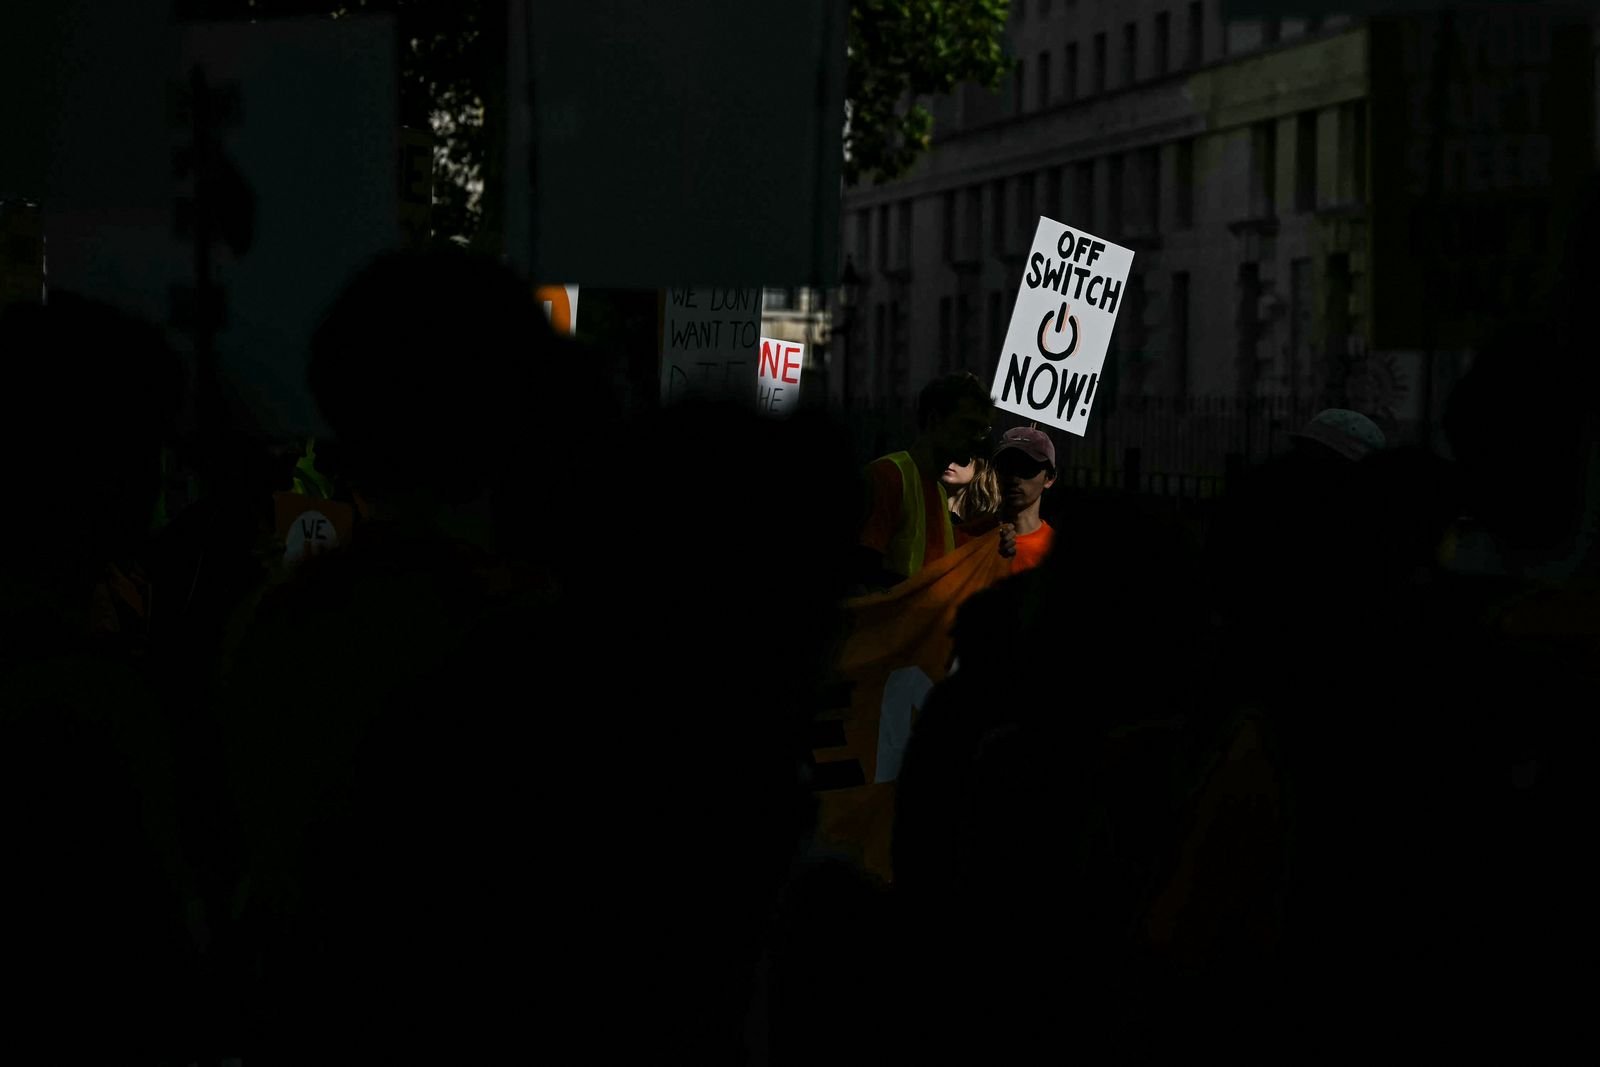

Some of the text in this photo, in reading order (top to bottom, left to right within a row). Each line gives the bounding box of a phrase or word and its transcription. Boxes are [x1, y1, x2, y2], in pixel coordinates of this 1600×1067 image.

[1057, 230, 1106, 267] OFF
[1026, 251, 1122, 314] SWITCH
[671, 319, 758, 351] WANT TO
[757, 340, 801, 384] NE
[1001, 353, 1098, 422] NOW!
[302, 518, 327, 540] WE
